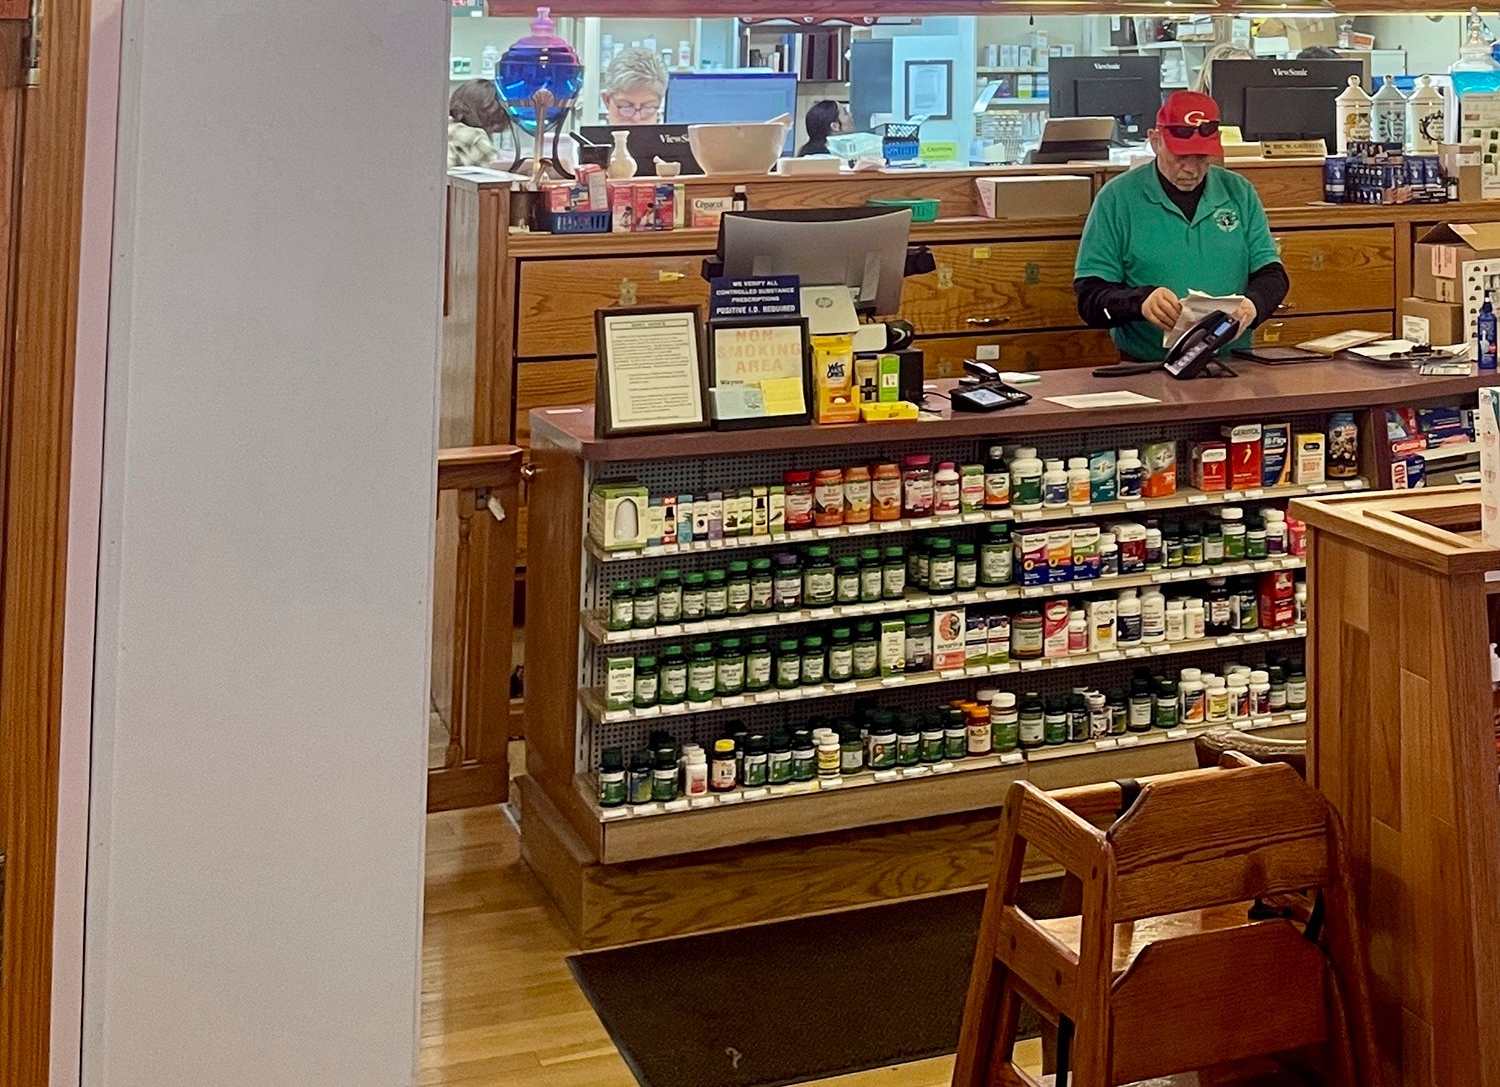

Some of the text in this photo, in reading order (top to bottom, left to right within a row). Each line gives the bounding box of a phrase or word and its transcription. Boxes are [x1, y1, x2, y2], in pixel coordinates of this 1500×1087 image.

[1272, 67, 1309, 76] ViewSonic
[715, 287, 796, 297] CONTROLLED SUBSTANCE
[731, 295, 781, 304] PRESCRIPTIONS
[716, 306, 748, 315] POSITIVE
[762, 304, 797, 314] REQUIRED
[716, 343, 800, 360] SMOKING
[734, 358, 784, 374] AREA
